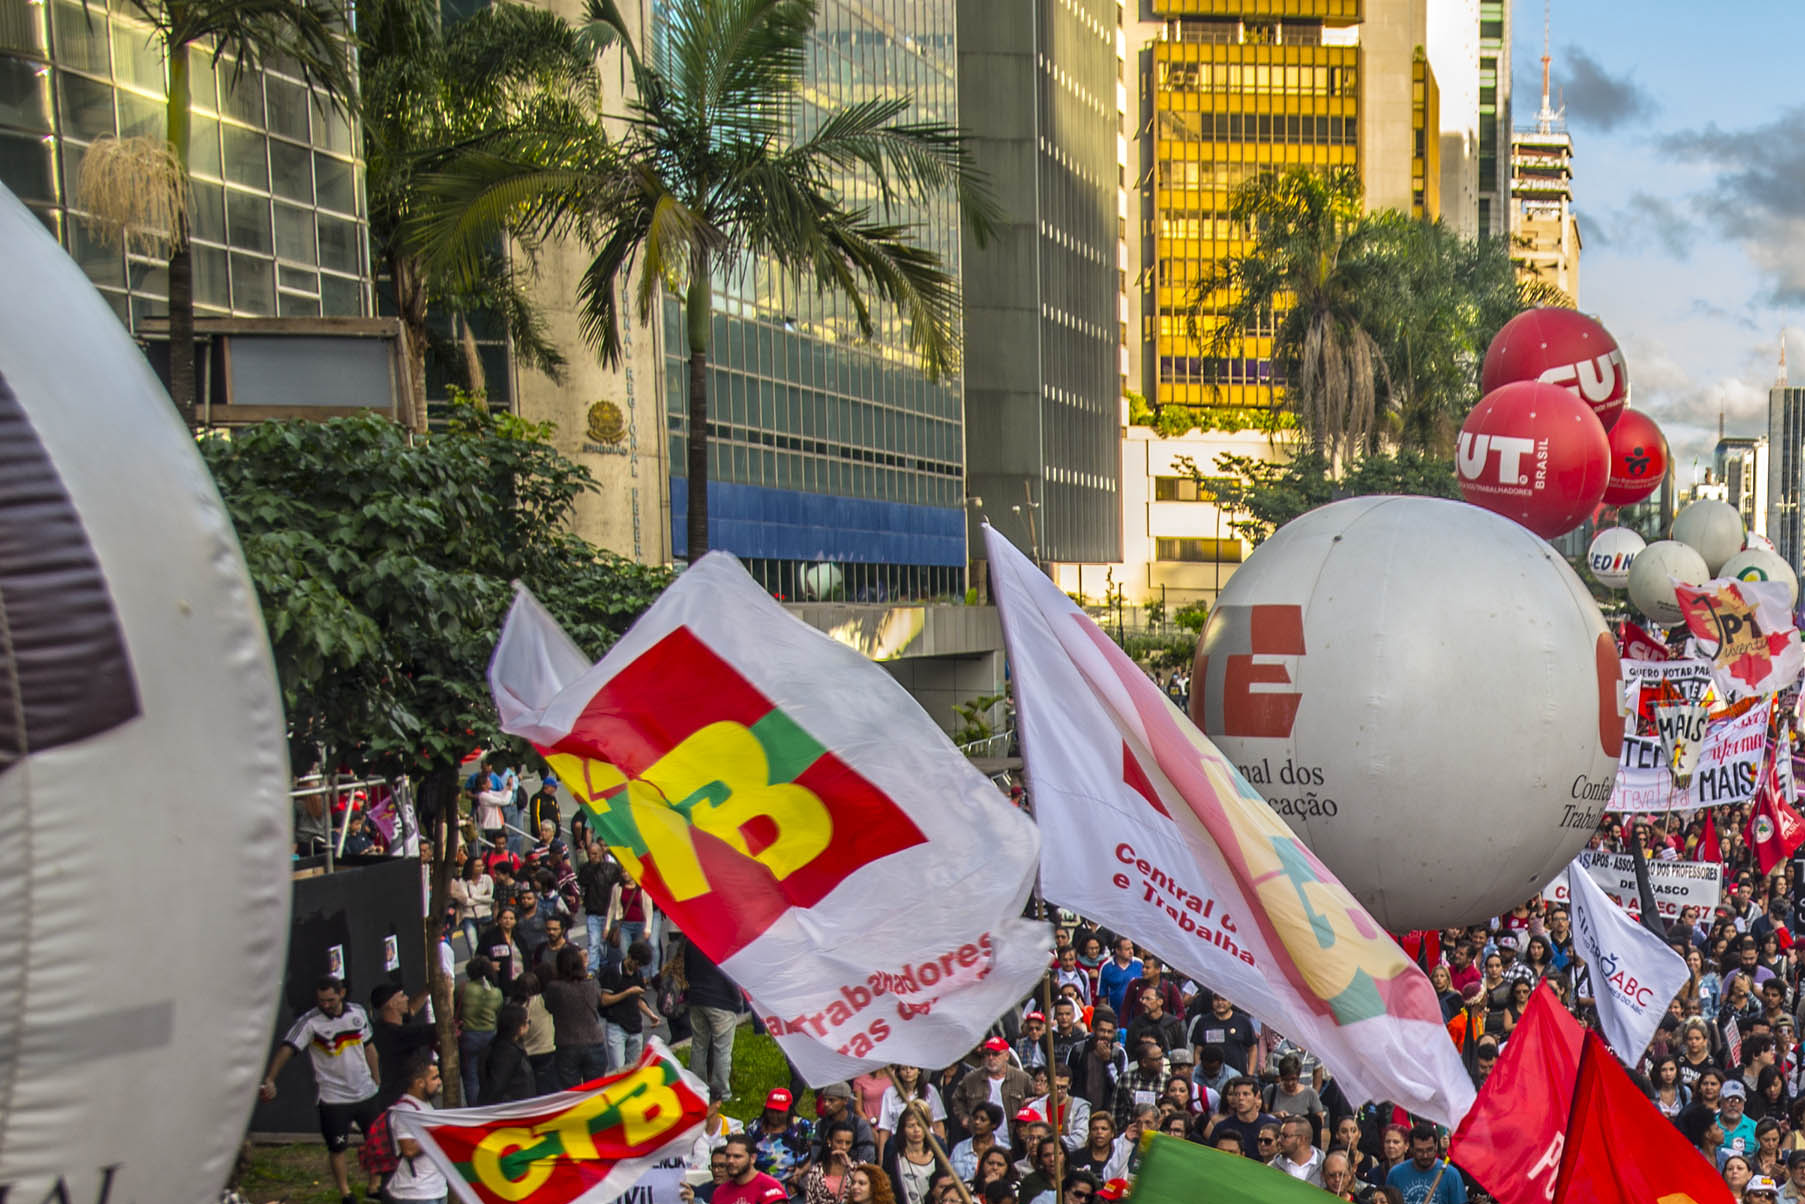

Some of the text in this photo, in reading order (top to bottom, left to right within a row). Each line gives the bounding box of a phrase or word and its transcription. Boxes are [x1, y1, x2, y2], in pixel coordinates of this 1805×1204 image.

[1456, 430, 1549, 489] UT BRASIL
[1629, 667, 1660, 678] QUERO
[1662, 667, 1692, 678] VOTAR
[1658, 713, 1704, 743] MAIS
[1281, 761, 1325, 785] dos
[1699, 761, 1755, 802] MAIS
[1113, 870, 1132, 888] e
[1114, 842, 1215, 918] Central
[1592, 853, 1718, 881] APOS DOS PROFESSORES
[1619, 879, 1636, 890] DE
[1658, 901, 1677, 915] EC
[473, 1064, 684, 1202] CTB
